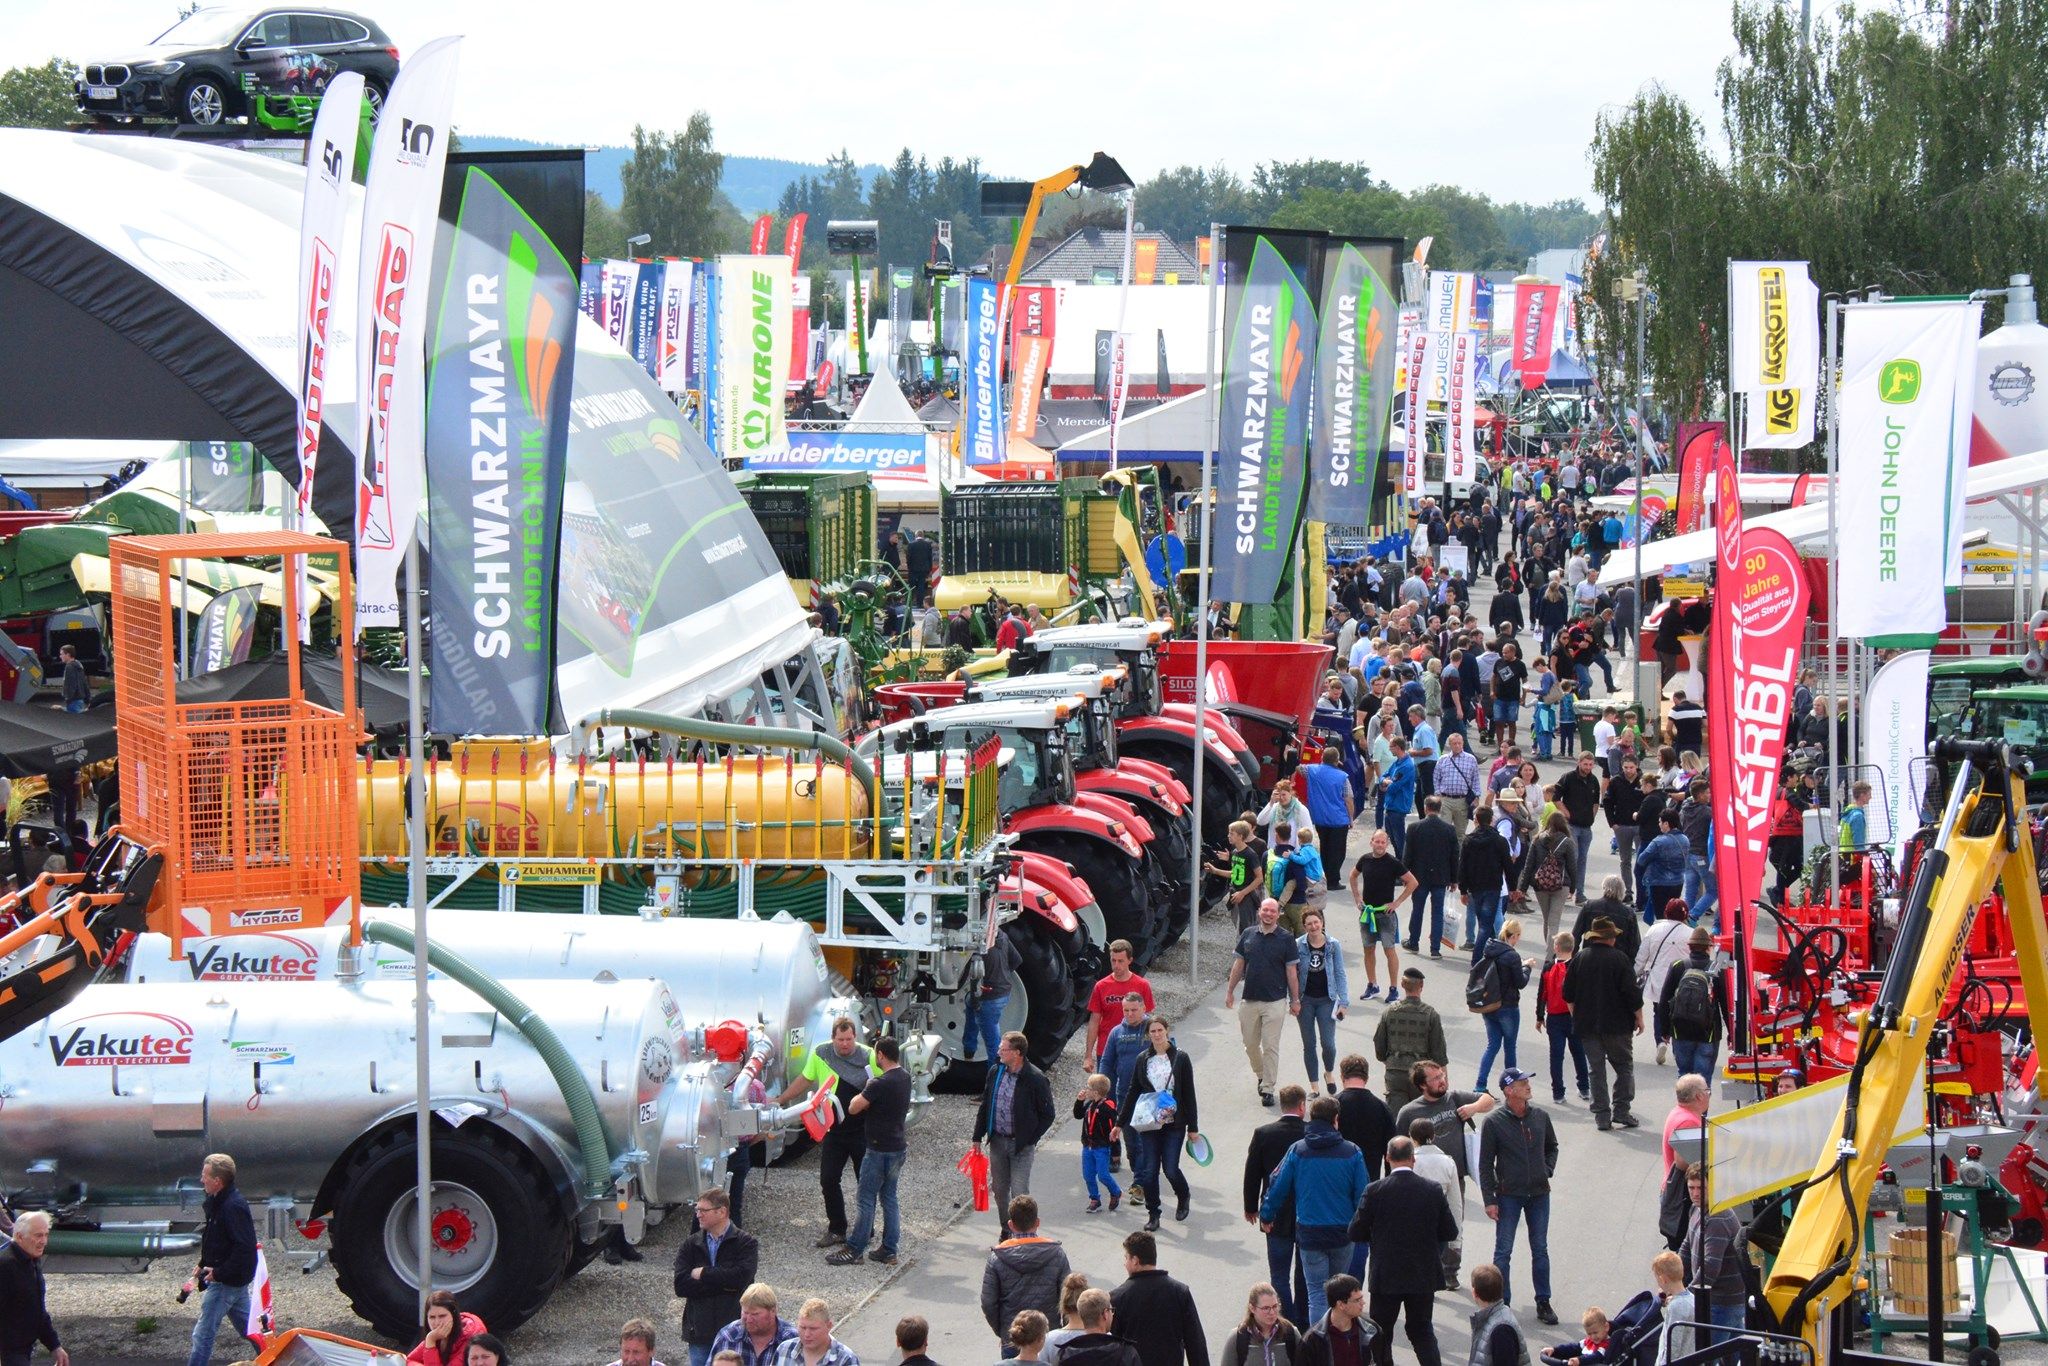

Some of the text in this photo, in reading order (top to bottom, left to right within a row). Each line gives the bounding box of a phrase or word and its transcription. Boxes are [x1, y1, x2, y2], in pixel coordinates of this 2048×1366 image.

[610, 273, 627, 341] OSCH
[667, 288, 678, 340] POSCH
[752, 270, 773, 407] KRONE
[1522, 289, 1545, 362] VALTRA
[1762, 271, 1787, 380] AGROTEL
[975, 287, 997, 461] Binderberger
[1016, 338, 1042, 433] Wood-Mizer
[1330, 294, 1357, 488] SCHWARZMAYR
[1236, 303, 1272, 554] SCHWARZMAYR
[1356, 371, 1370, 485] LANDTECHNIK
[467, 273, 511, 659] SCHWARZMAYR
[1261, 406, 1287, 551] LANDTECHNIK
[1879, 415, 1906, 582] JOHN DEERE
[519, 425, 544, 652] LANDTECHNIK
[1744, 553, 1767, 576] 90
[1742, 586, 1789, 613] Qualität aus
[1742, 611, 1760, 626] dem
[1743, 574, 1781, 599] Jahre
[1053, 641, 1120, 649] www.schwarzmayr.at
[996, 688, 1067, 697] www.schwarzmayr.at
[1746, 646, 1796, 853] KERBL
[522, 867, 596, 875] ZUNHAMMER
[242, 914, 299, 926] HYDRAC
[187, 945, 319, 981] Vakutec
[49, 1026, 194, 1067] Vakutec
[791, 1029, 800, 1045] 25
[641, 1104, 651, 1122] 25
